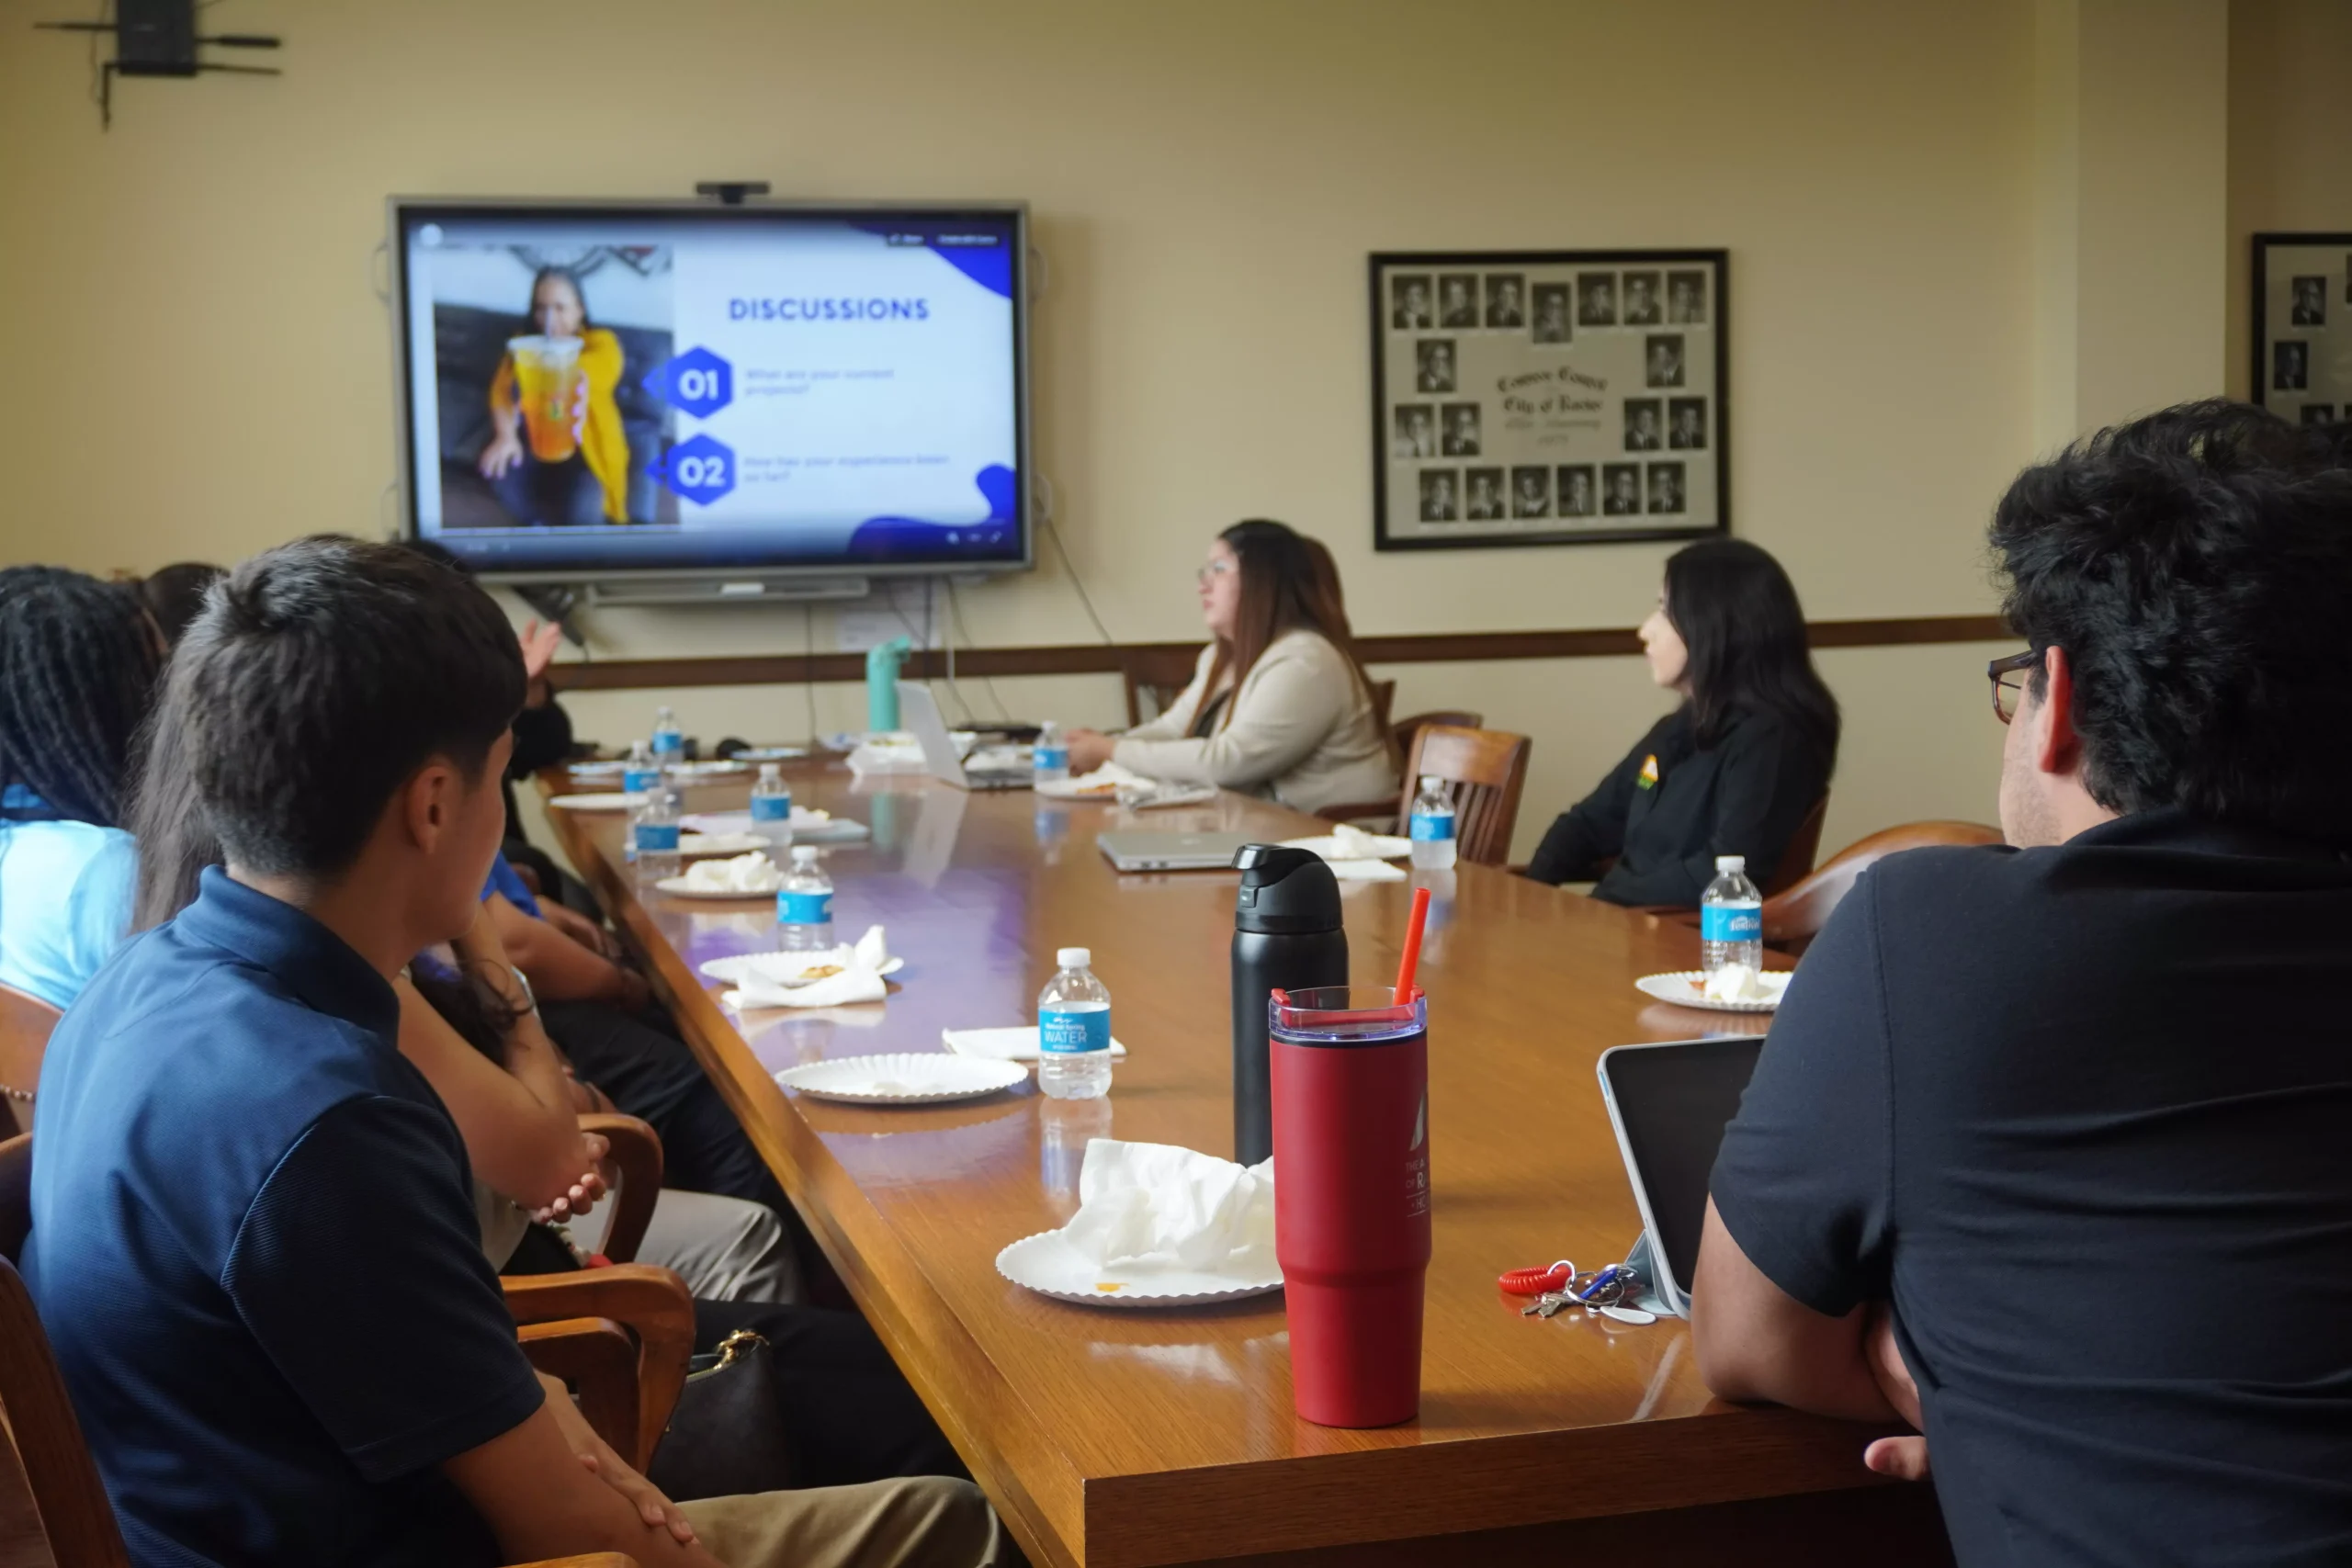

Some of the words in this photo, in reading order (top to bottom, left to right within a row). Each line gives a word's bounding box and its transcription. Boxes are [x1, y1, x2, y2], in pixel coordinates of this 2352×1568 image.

[729, 298, 929, 321] DISCUSSIONS
[678, 368, 719, 400] 01
[677, 456, 727, 488] 02
[1045, 1031, 1088, 1043] WATER
